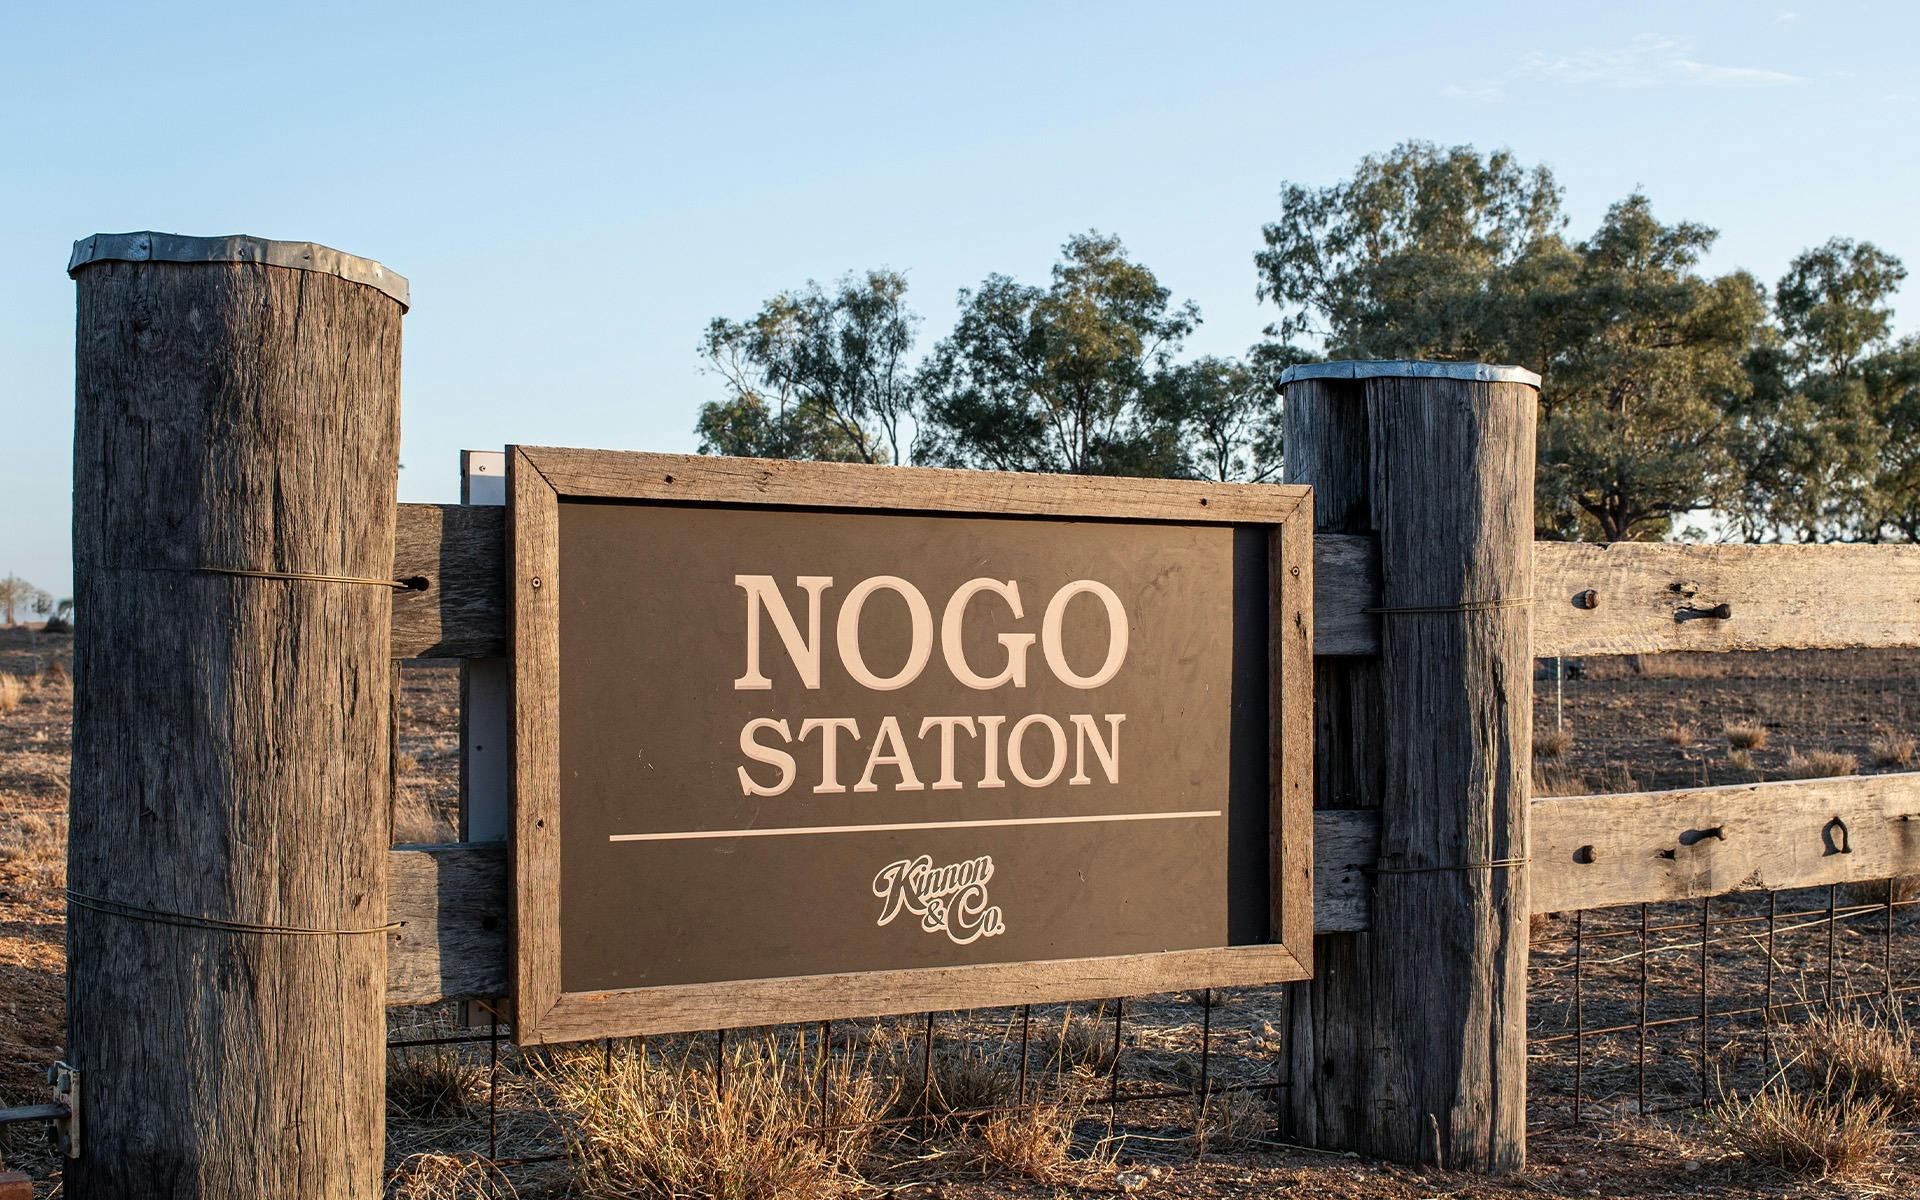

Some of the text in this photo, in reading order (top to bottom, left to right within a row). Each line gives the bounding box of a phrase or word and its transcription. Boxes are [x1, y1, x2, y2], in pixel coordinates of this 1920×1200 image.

[735, 574, 1129, 691] NOGO
[737, 713, 1127, 797] STATION
[873, 854, 995, 926] Kinnon
[922, 882, 1006, 945] & Co.
